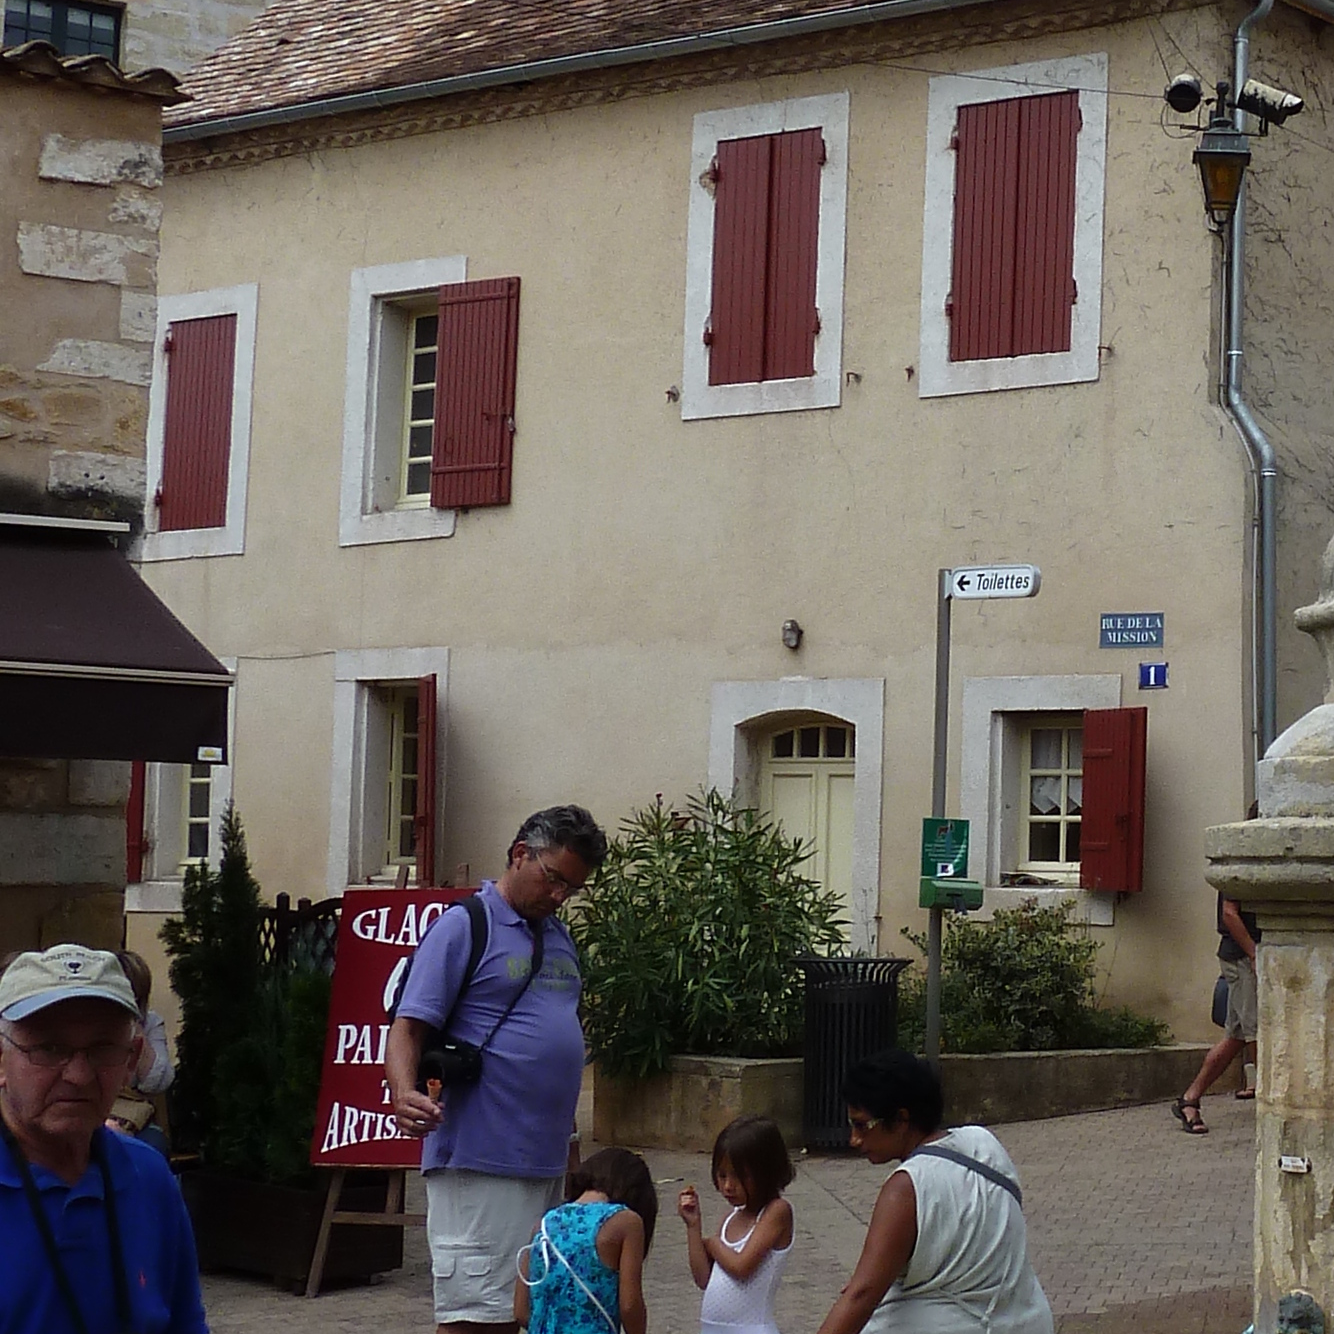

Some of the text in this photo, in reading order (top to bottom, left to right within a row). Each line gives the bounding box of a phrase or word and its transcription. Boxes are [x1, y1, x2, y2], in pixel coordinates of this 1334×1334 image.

[977, 573, 1030, 591] Toilettes
[1102, 617, 1162, 629] RUE DE LA
[1107, 630, 1158, 643] MISSION
[1149, 666, 1156, 685] 1
[352, 902, 449, 946] GLAC
[333, 1024, 390, 1064] PAI
[320, 1101, 419, 1153] ARTIS
